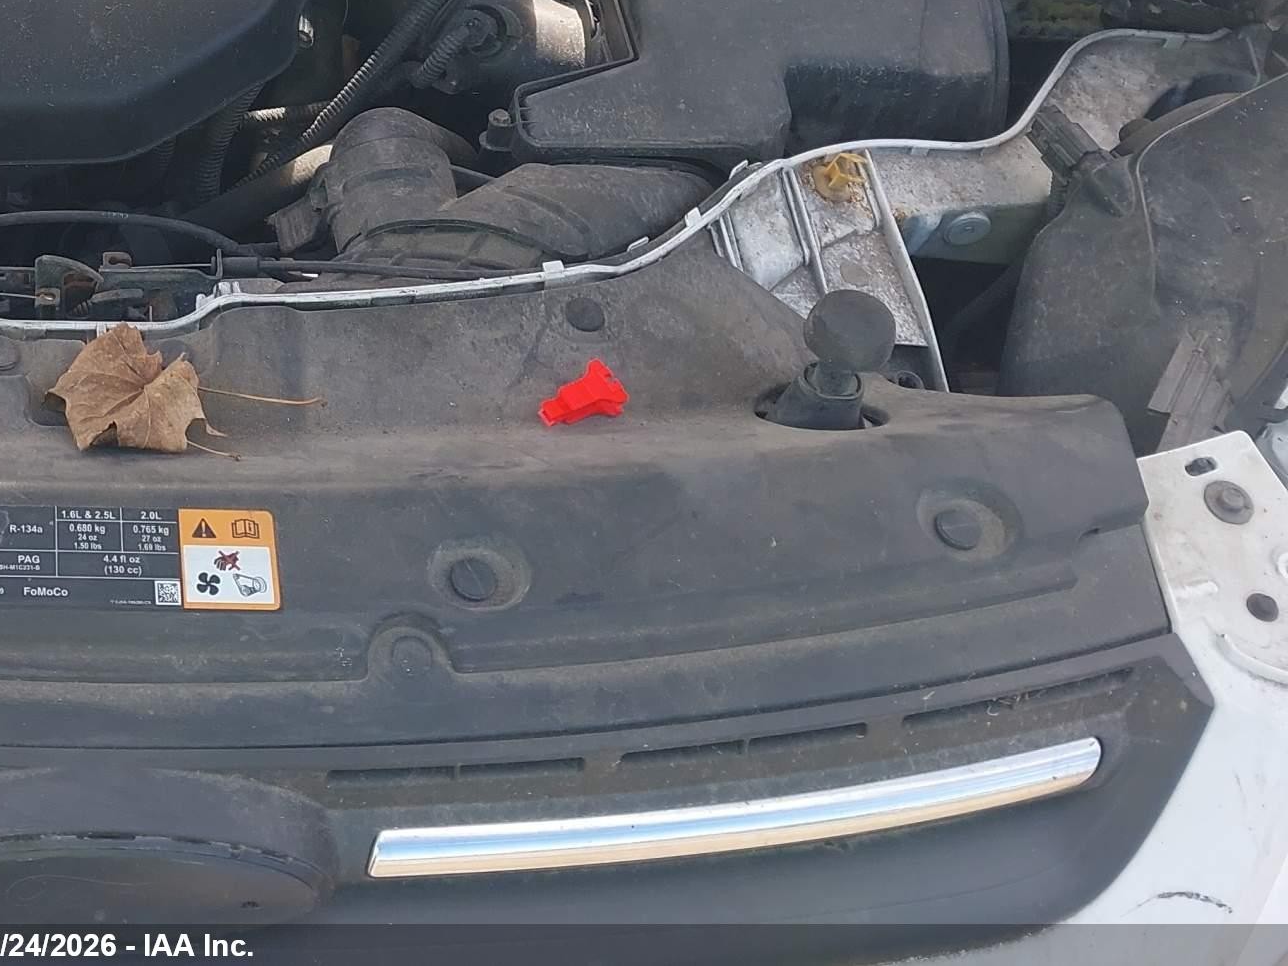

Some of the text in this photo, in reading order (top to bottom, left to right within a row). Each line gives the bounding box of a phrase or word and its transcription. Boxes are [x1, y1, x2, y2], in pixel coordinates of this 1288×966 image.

[84, 510, 92, 519] &
[94, 511, 117, 520] 2.5L
[140, 511, 163, 521] 2.0L
[9, 524, 44, 534] R-134a
[94, 523, 106, 535] kg
[133, 525, 170, 536] 0.765 kg
[77, 534, 87, 542] 24
[74, 542, 102, 550] 1.50 lbs
[154, 543, 166, 552] lbs
[17, 554, 41, 564] PAG
[103, 554, 141, 564] 4.4 fl oz
[104, 565, 142, 577] (130 cc)
[23, 586, 69, 597] FoMoCo
